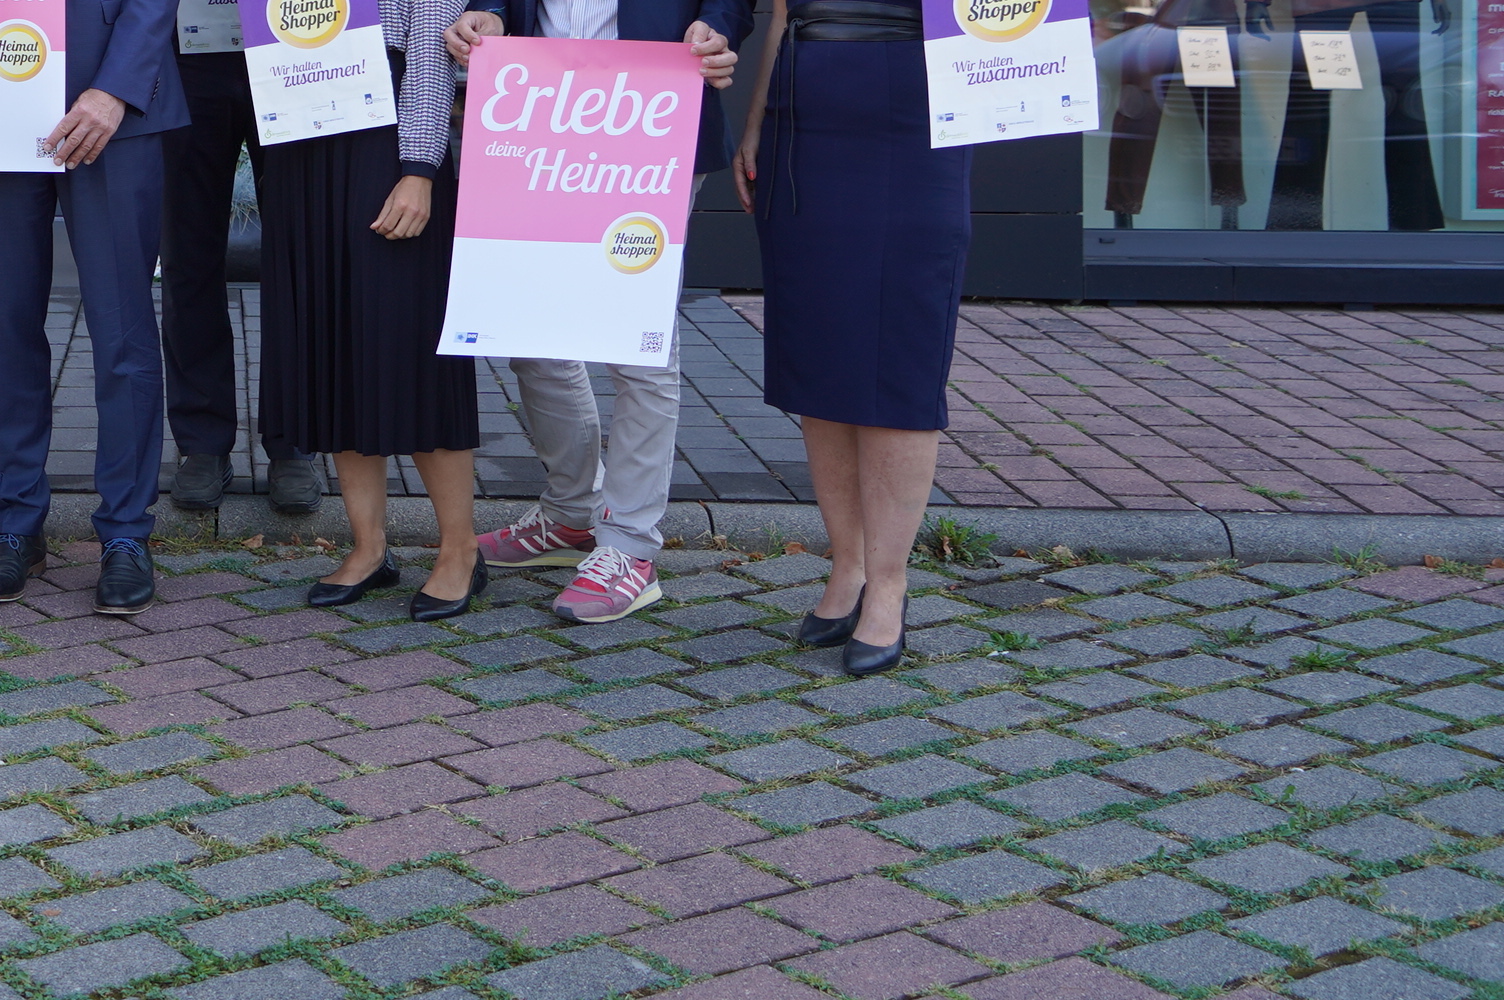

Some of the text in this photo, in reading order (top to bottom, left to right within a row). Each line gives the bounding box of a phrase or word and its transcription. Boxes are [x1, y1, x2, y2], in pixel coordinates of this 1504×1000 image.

[280, 10, 340, 30] Shopper
[967, 0, 1041, 22] Shopper
[270, 61, 322, 77] Wir halten
[283, 58, 366, 88] zusammen!
[952, 56, 1014, 74] Wir halten
[967, 56, 1067, 86] zusammen!
[480, 63, 679, 138] Erlebe
[485, 140, 679, 195] deine Heimat
[614, 232, 658, 246] Heimat
[610, 244, 658, 259] shoppen
